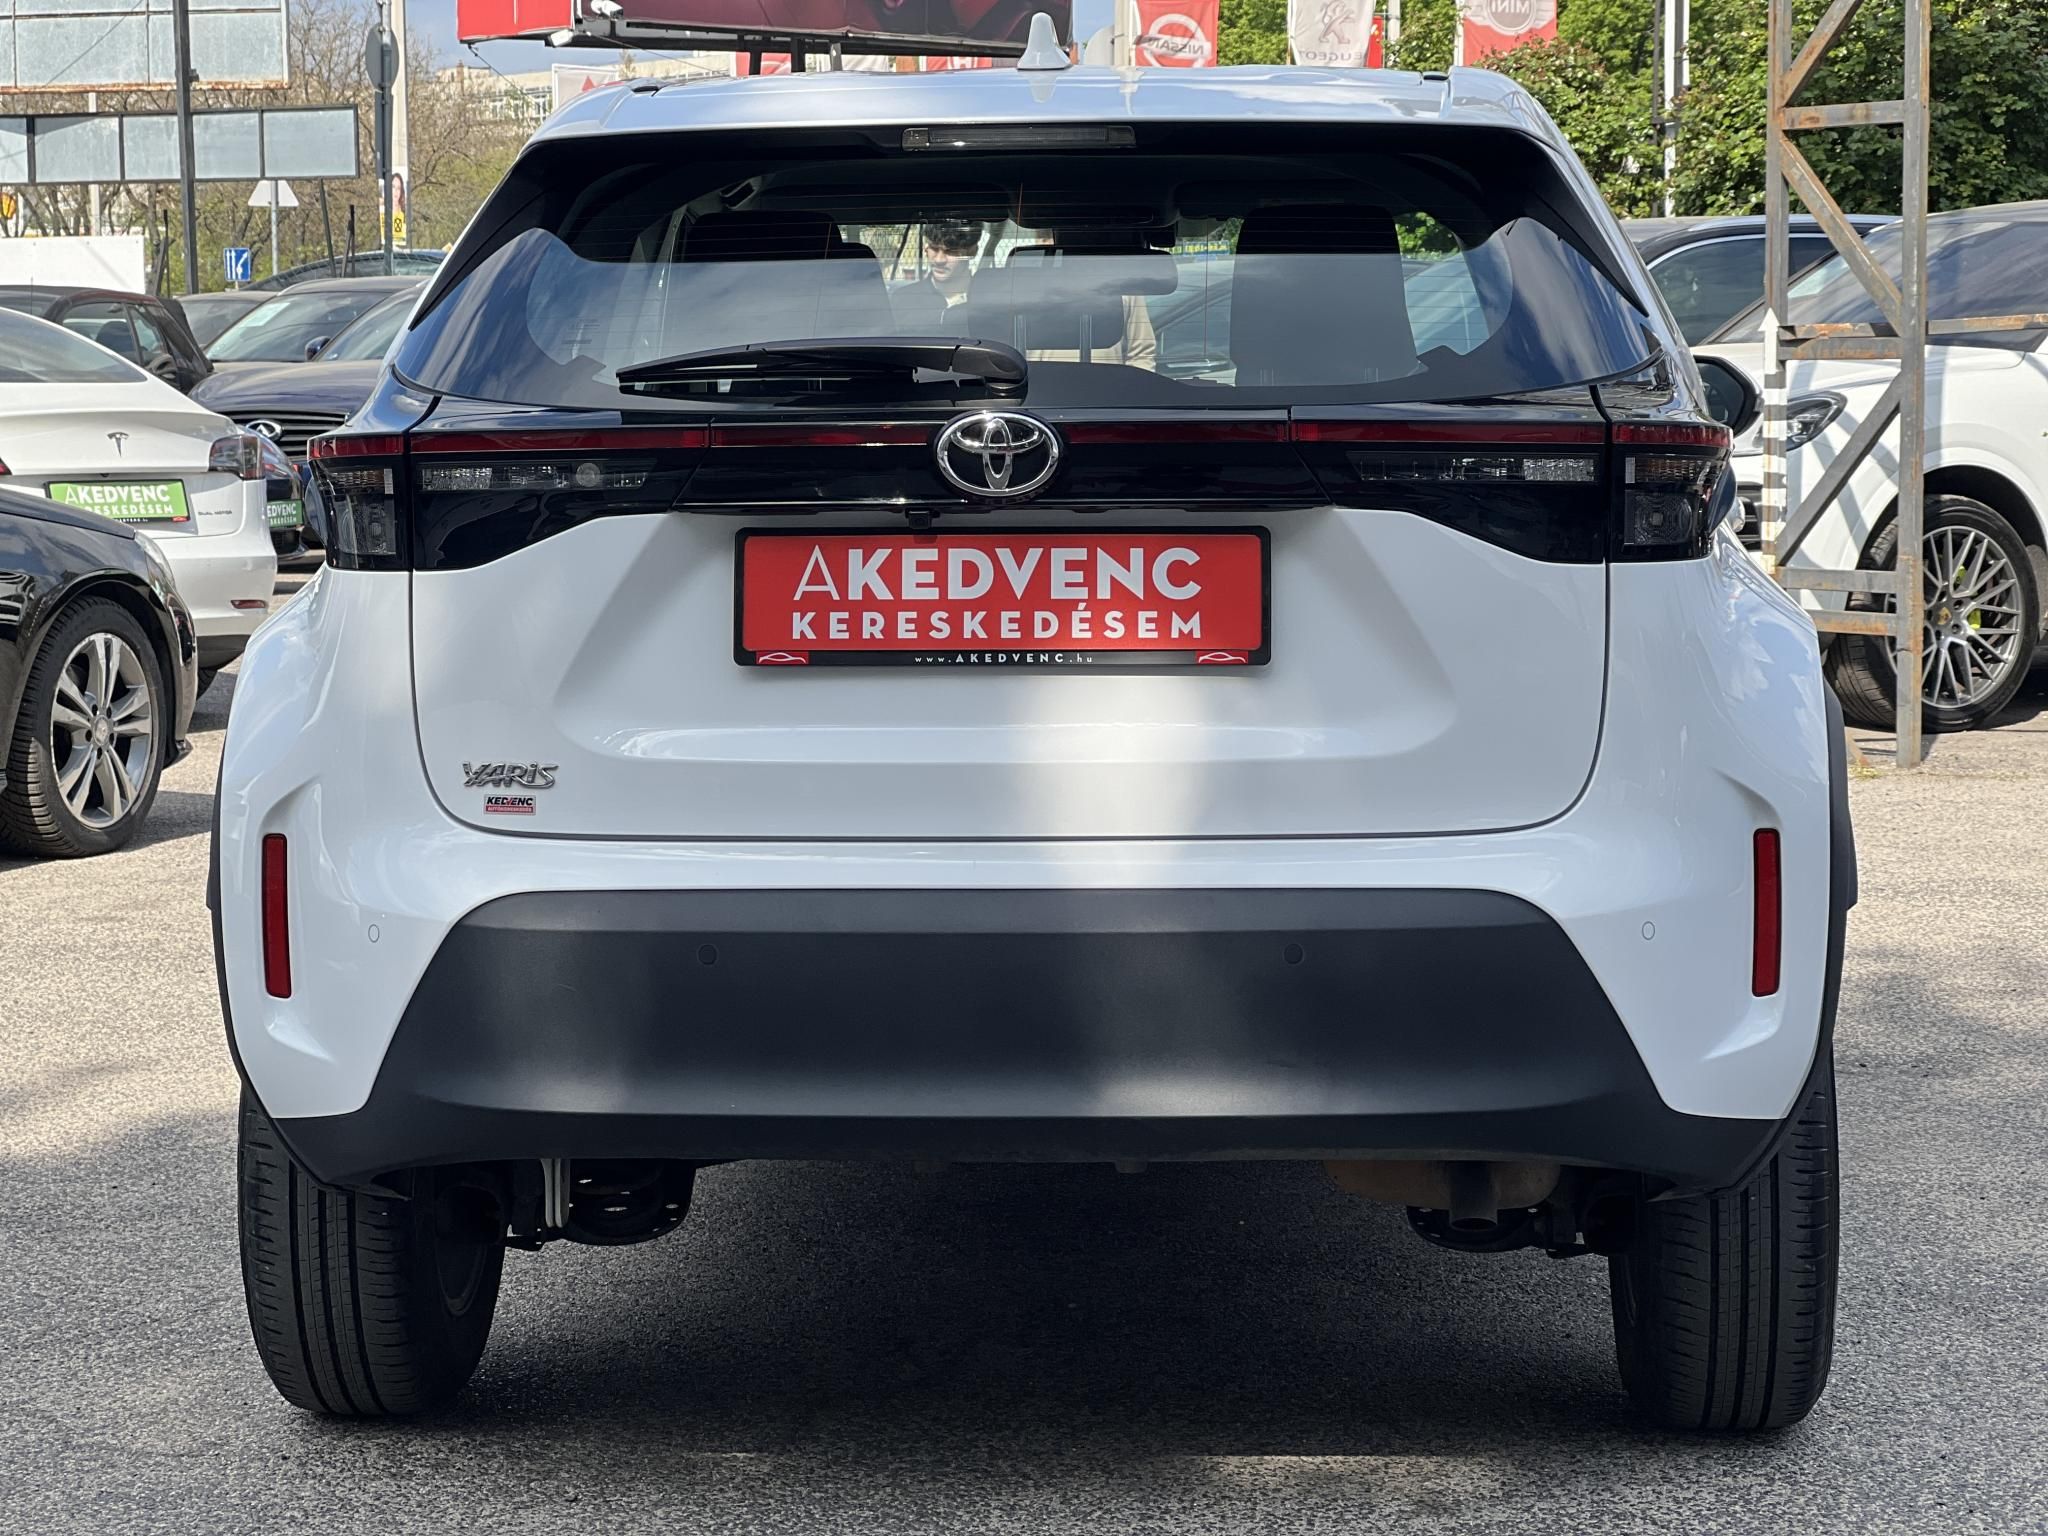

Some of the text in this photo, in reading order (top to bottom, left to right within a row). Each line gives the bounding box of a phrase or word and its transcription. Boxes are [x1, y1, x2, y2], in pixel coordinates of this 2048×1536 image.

[65, 485, 170, 504] AKEDVENC
[267, 503, 297, 517] EDVENC
[793, 545, 1202, 602] AKEDVENC
[792, 603, 1202, 640] KERESKEDÉSEM
[915, 653, 1093, 664] www.AKEDVENC.hu
[487, 796, 533, 805] KEDVENC
